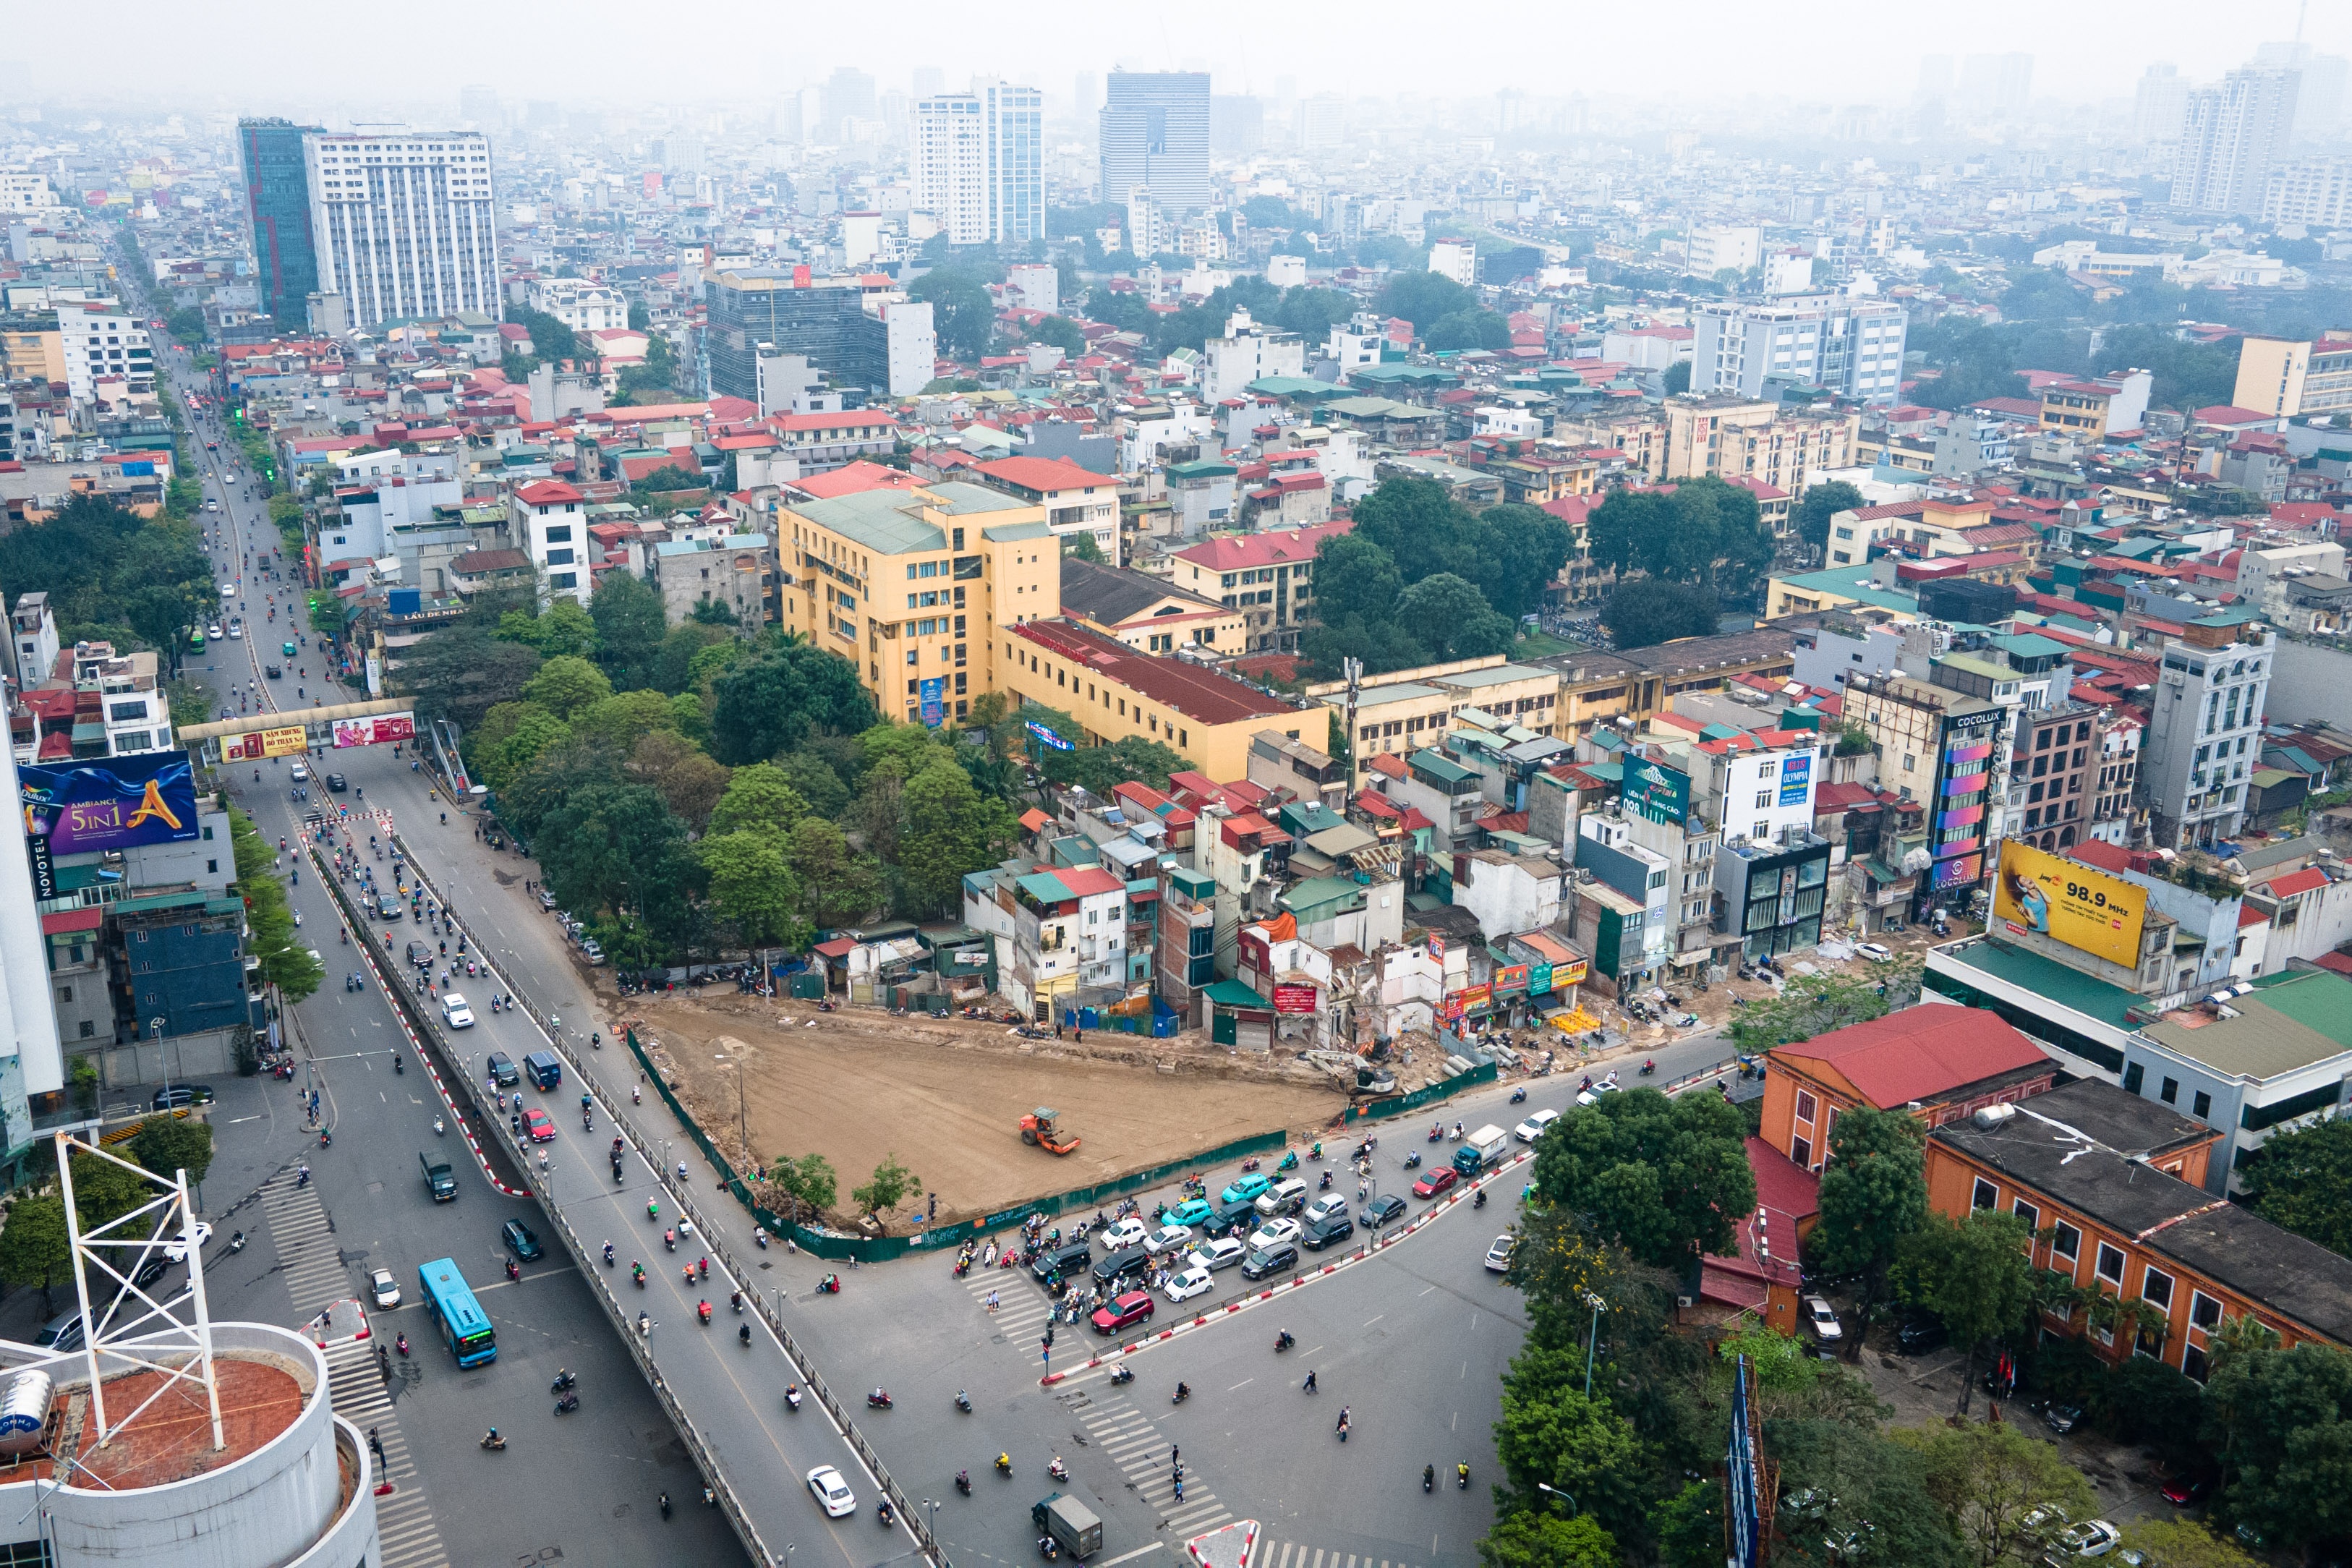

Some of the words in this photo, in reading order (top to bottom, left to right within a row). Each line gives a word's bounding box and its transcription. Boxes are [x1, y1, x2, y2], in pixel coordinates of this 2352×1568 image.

[1958, 711, 2001, 727] COCOLUX
[1787, 759, 1807, 771] IELTS
[1783, 770, 1808, 783] OLYMPIA
[21, 788, 51, 803] Dulux
[71, 798, 117, 809] AMBIANCE
[34, 838, 51, 898] NOVOTEL
[1935, 872, 1974, 889] COCOLUX
[2066, 882, 2106, 908] 98.9
